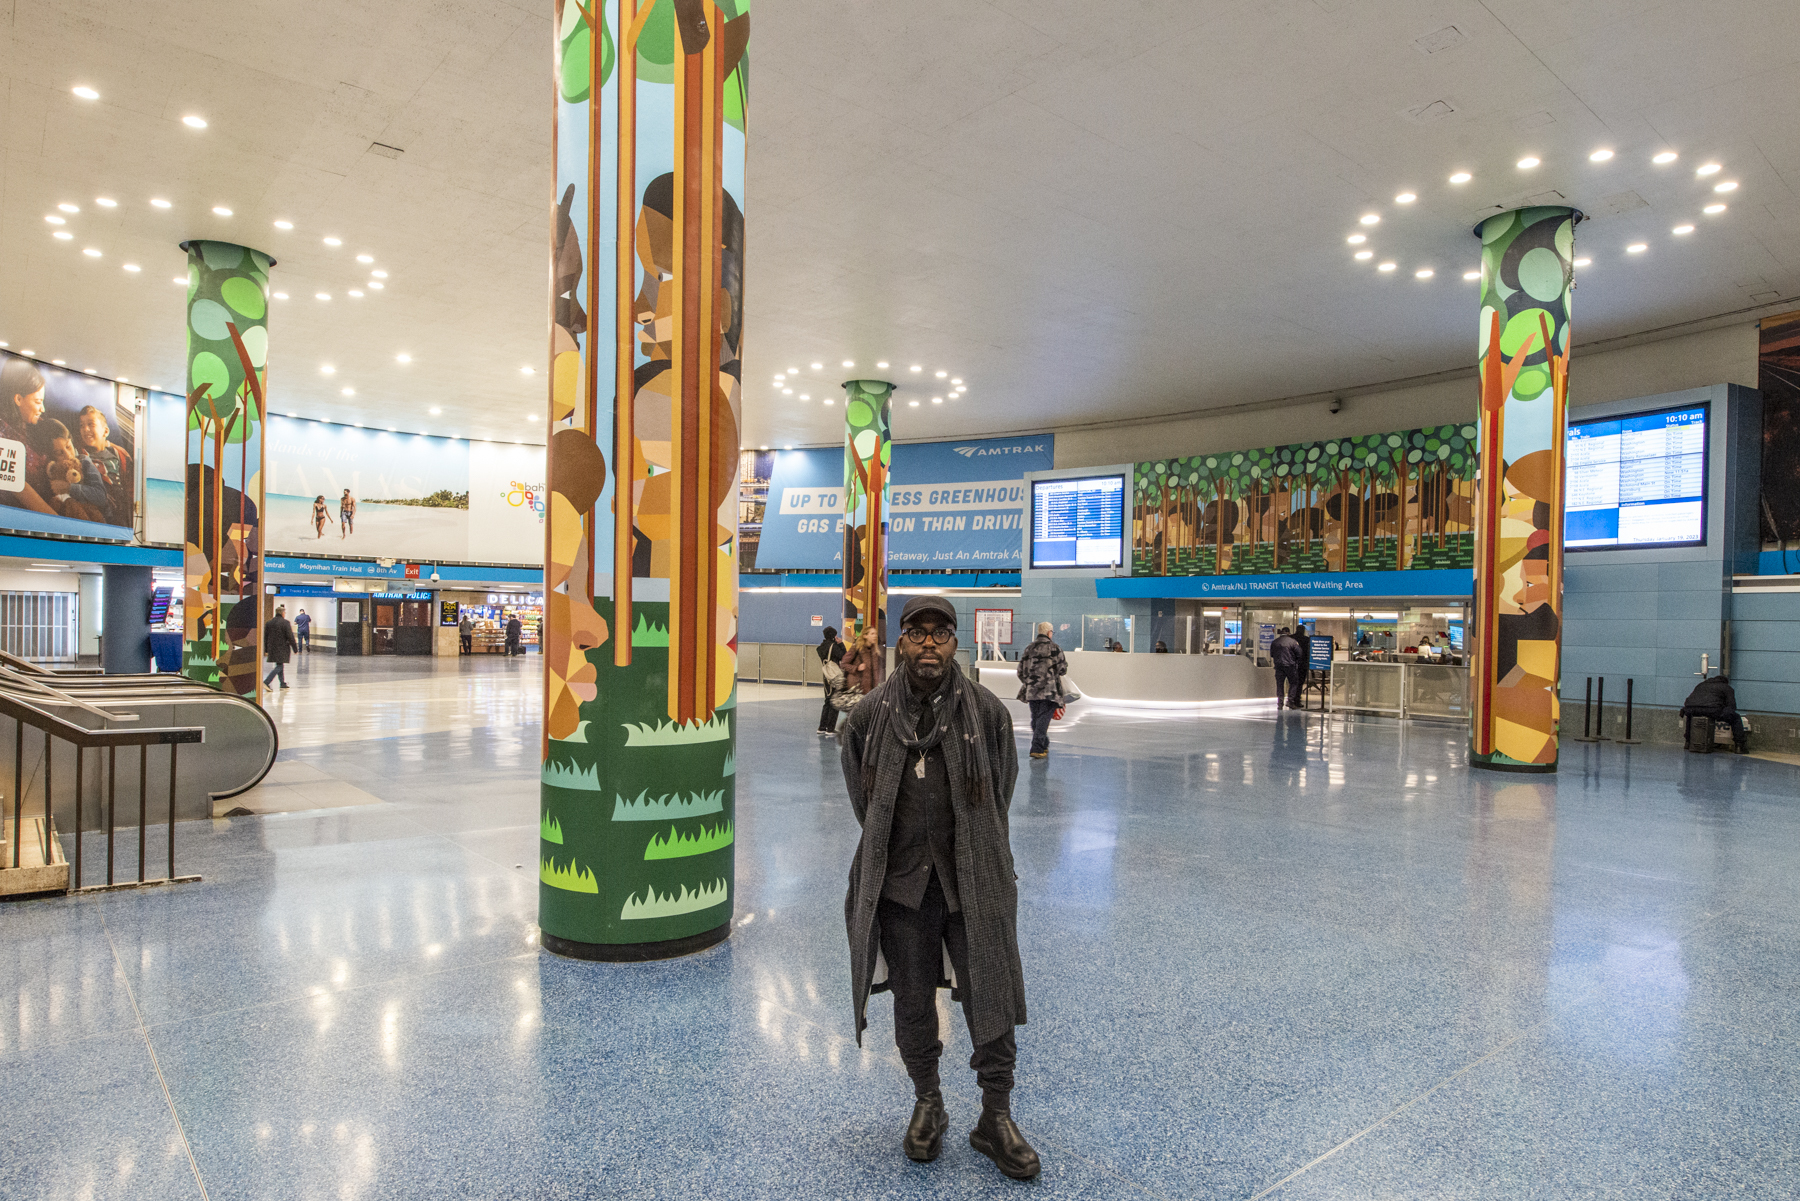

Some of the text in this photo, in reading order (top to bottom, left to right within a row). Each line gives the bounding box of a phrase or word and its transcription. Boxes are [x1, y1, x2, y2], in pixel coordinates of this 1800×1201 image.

[1666, 414, 1688, 423] 10:10
[7, 449, 16, 459] IN
[266, 438, 359, 462] slands of the
[978, 444, 1044, 456] AMTRAK
[525, 482, 544, 491] bah
[790, 494, 815, 508] UP
[817, 493, 838, 507] TO
[891, 491, 922, 506] ESS
[797, 519, 830, 533] GAS
[922, 516, 967, 532] THAN
[834, 552, 841, 560] A
[932, 551, 953, 560] Just
[956, 551, 970, 560] An
[972, 549, 1010, 560] Amtrak
[300, 563, 330, 573] Moynihan
[1212, 582, 1247, 591] Amtrak/NJ
[1314, 581, 1342, 590] Waiting
[1345, 581, 1363, 589] Area
[406, 592, 432, 600] POLICE
